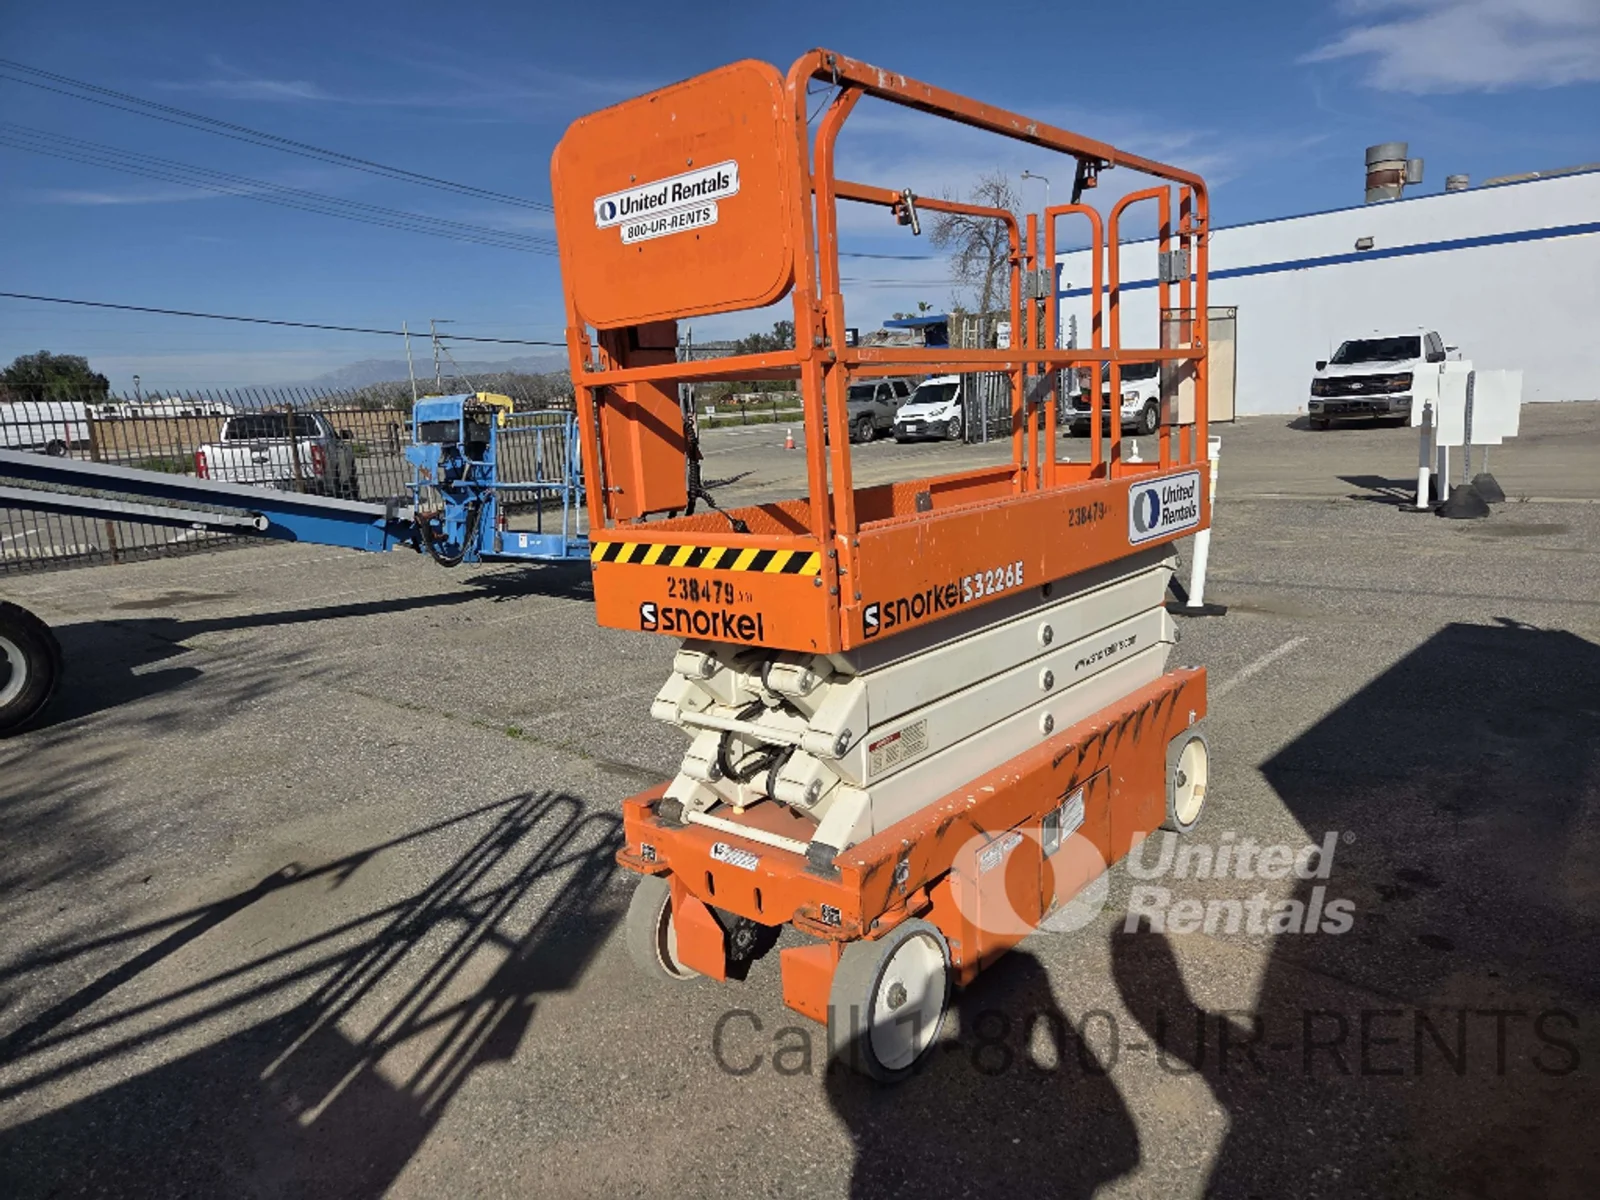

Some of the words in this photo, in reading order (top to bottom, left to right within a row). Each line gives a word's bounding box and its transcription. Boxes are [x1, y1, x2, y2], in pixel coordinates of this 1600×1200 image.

[620, 186, 668, 215] United
[671, 171, 730, 203] Rentals
[627, 207, 711, 239] 800-UR-RENTS
[1162, 480, 1195, 506] United
[1068, 502, 1105, 527] 238479
[1161, 500, 1197, 526] Rentals
[667, 576, 734, 605] 238479
[883, 577, 964, 629] snorkel
[963, 560, 1024, 603] S3226E
[661, 607, 764, 642] snorkel
